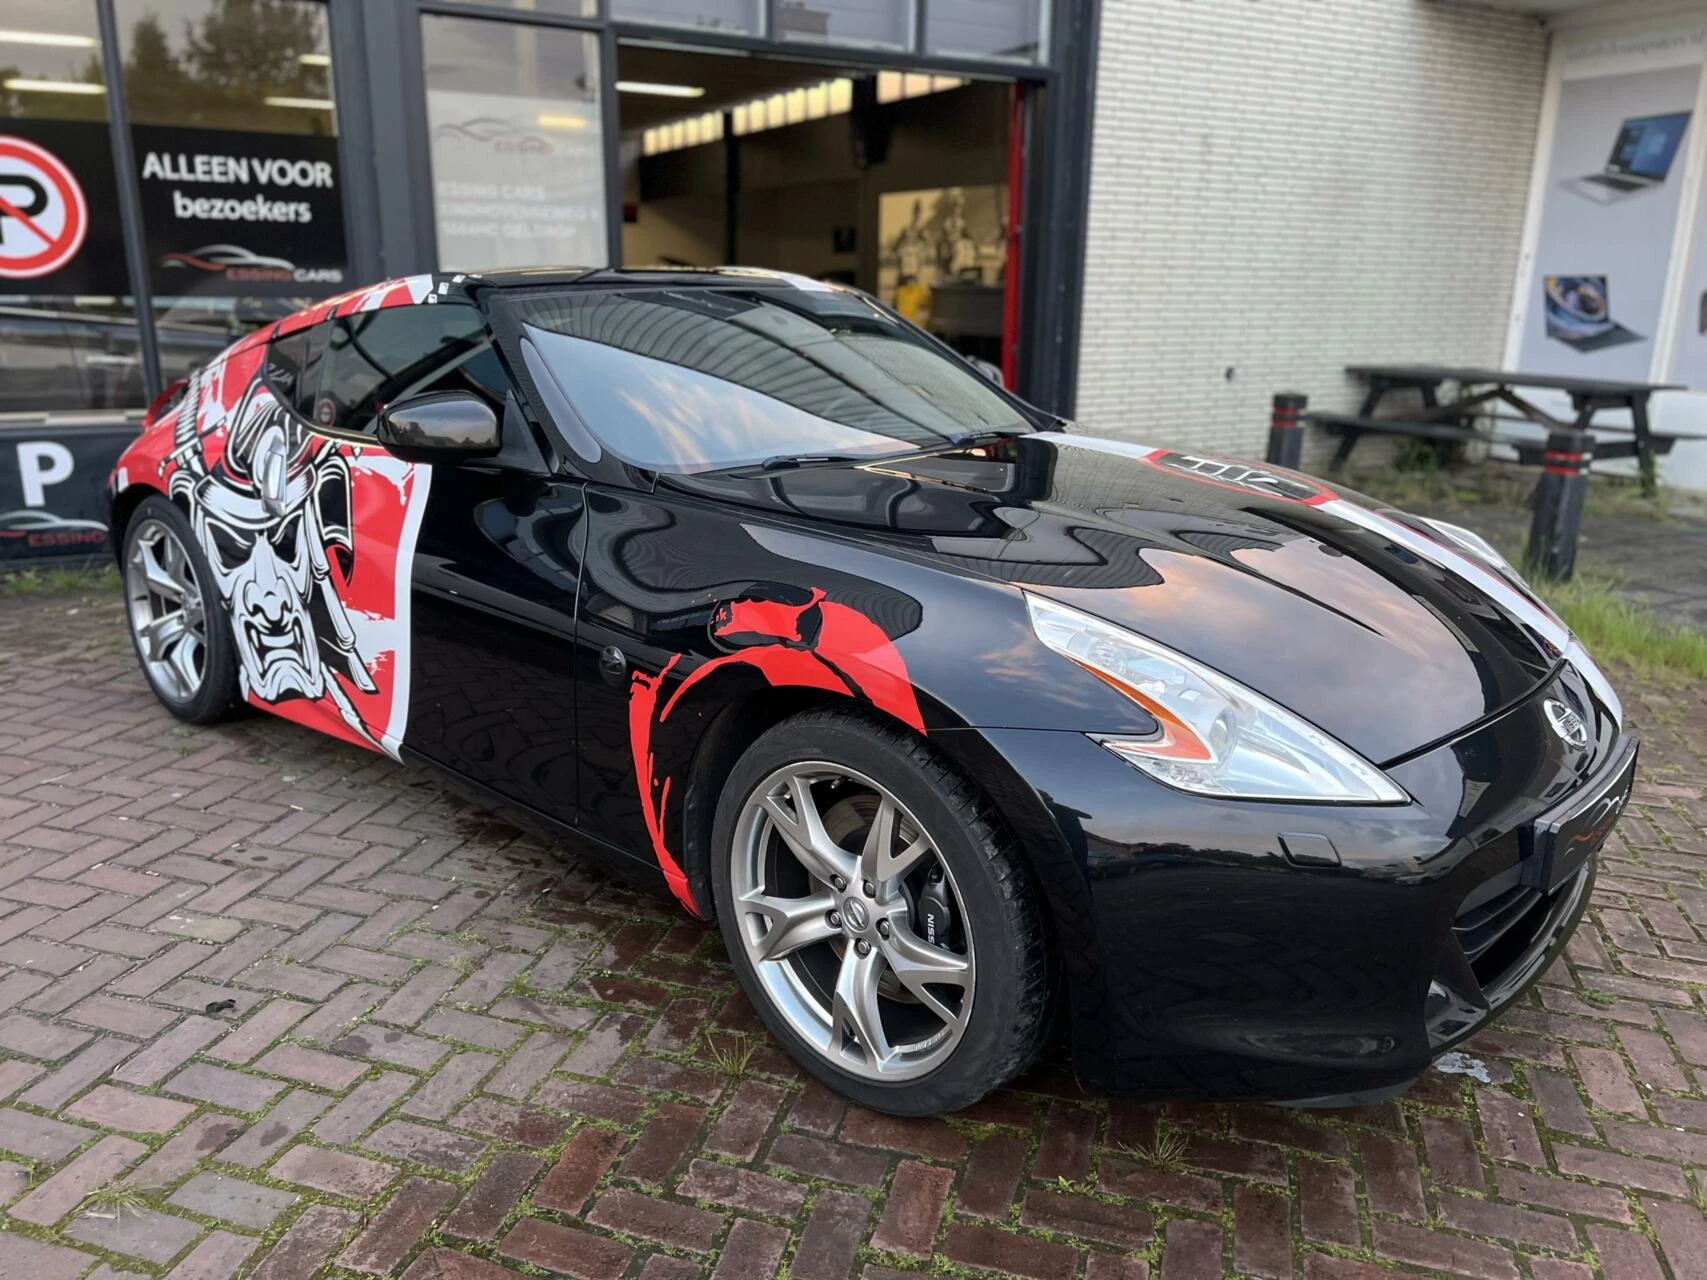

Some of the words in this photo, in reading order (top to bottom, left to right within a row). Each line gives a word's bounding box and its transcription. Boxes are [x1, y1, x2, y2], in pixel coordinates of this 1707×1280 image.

[142, 152, 248, 184] ALLEEN
[251, 157, 334, 188] VOOR
[172, 190, 312, 223] bezoekers
[293, 268, 343, 284] CARS
[16, 441, 75, 507] P
[927, 913, 935, 944] NISS
